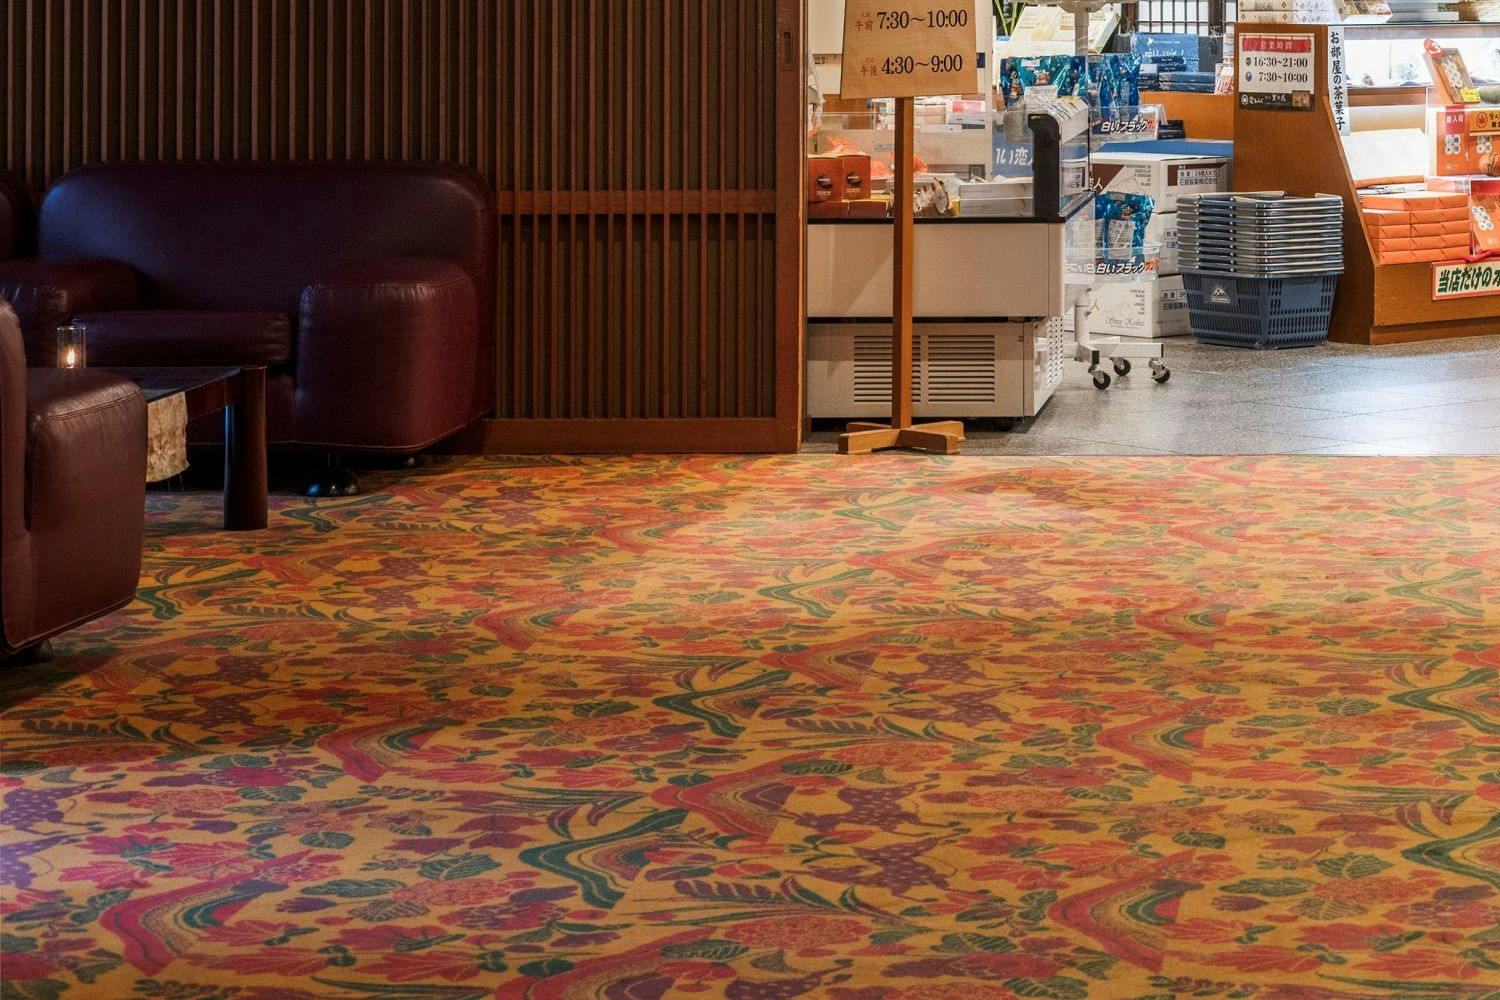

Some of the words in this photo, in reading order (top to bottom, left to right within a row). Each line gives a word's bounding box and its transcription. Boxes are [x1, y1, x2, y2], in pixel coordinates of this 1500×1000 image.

[854, 20, 874, 31] 午前
[860, 65, 879, 77] 午後
[1330, 31, 1345, 131] お部屋の茶菓子
